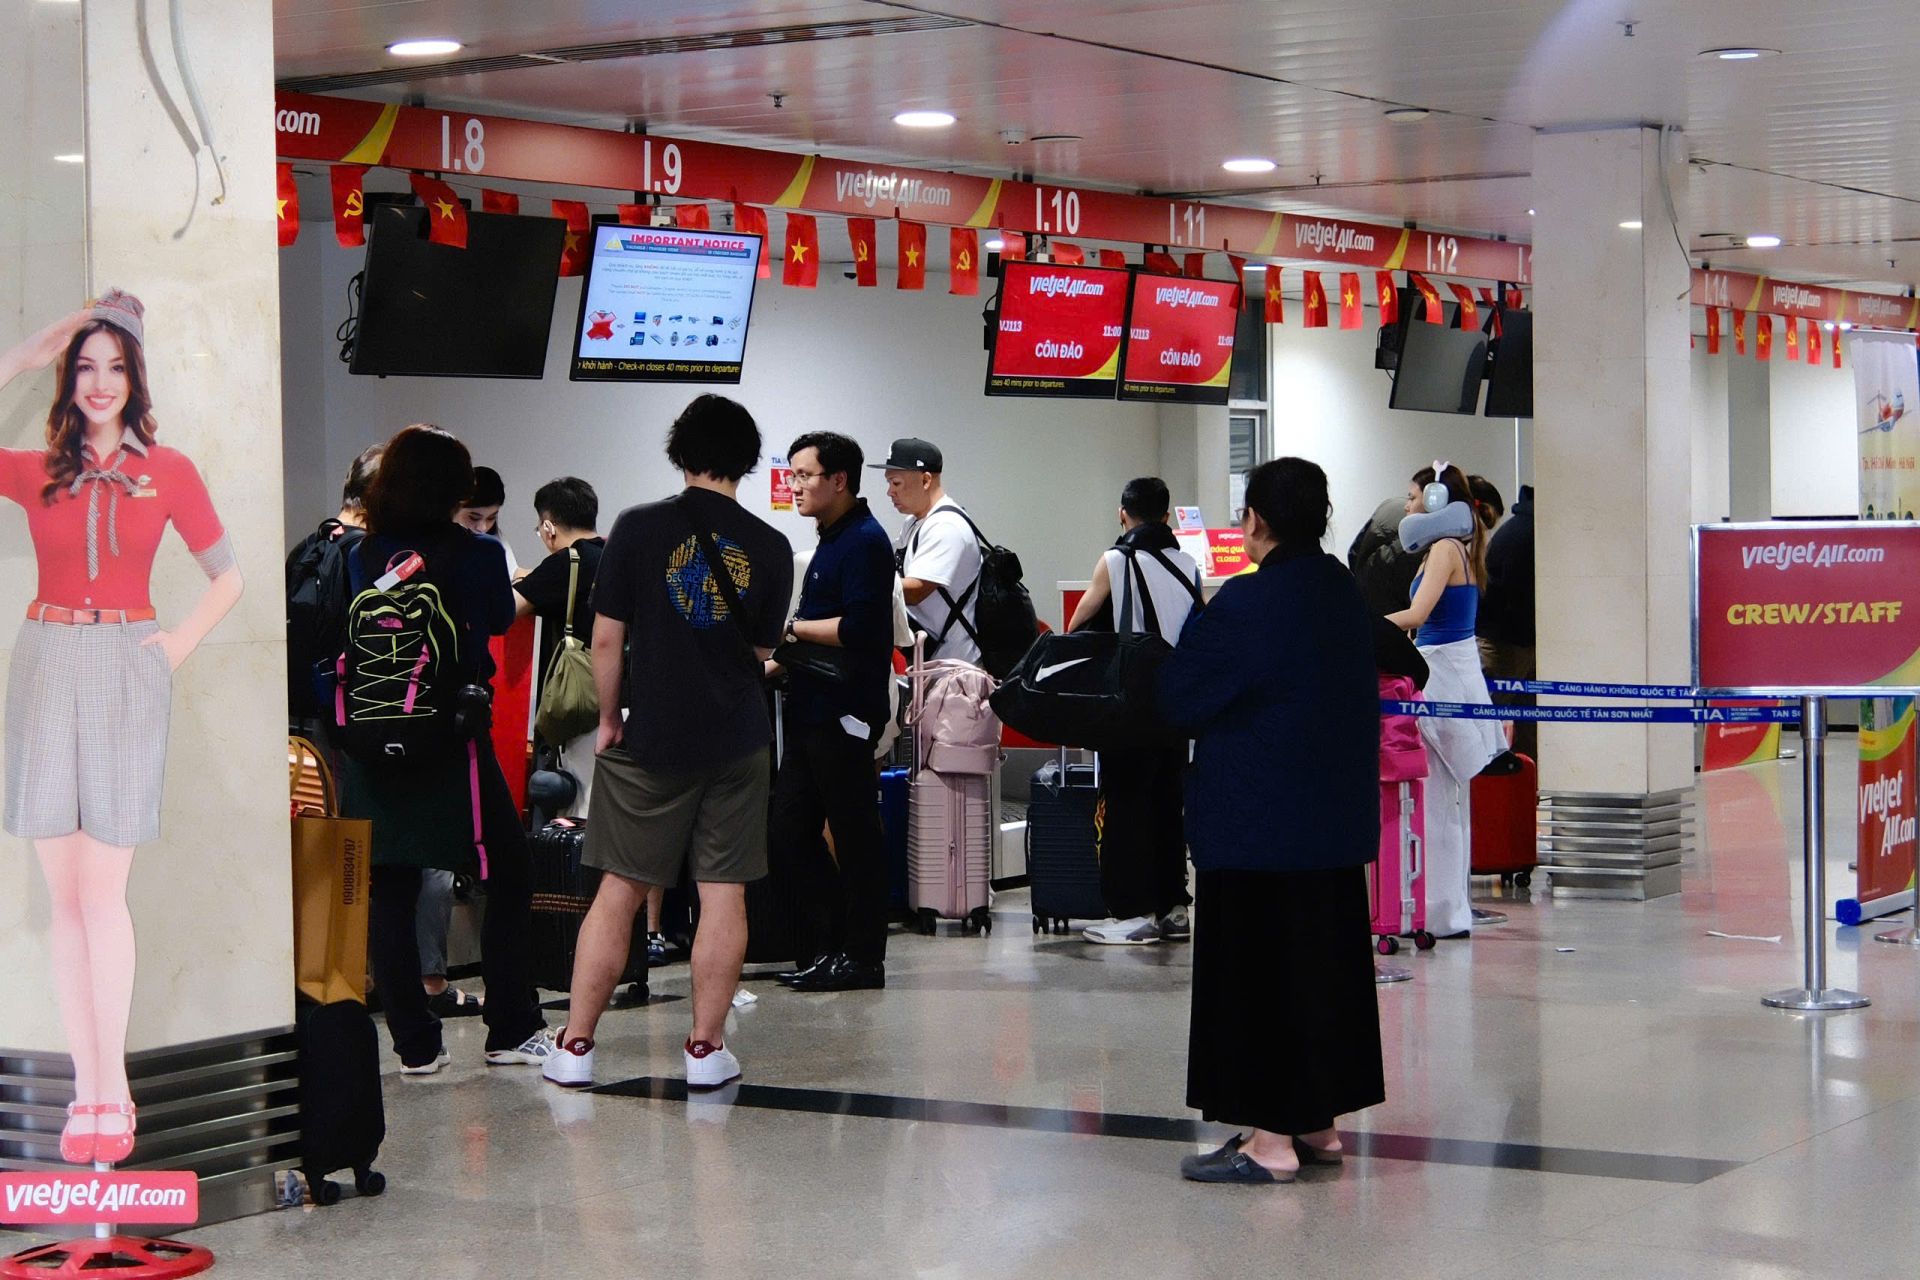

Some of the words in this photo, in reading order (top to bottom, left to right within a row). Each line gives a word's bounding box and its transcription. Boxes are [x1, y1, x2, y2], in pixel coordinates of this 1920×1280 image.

[442, 115, 485, 173] I.8
[643, 140, 682, 194] I.9
[1036, 188, 1080, 234] I.10
[1169, 203, 1206, 246] I.11
[631, 234, 700, 247] IMPORTANT
[703, 239, 745, 251] NOTICE
[1426, 234, 1458, 274] I.12
[1704, 272, 1728, 306] I.14
[1000, 320, 1022, 332] VJ113
[1102, 326, 1122, 336] 11:00
[1035, 340, 1058, 358] CÔN
[1060, 340, 1083, 359] ĐẢO
[1160, 348, 1179, 366] CÔN
[618, 362, 645, 370] Check-in
[646, 362, 665, 371] closes
[667, 363, 674, 371] 40
[690, 364, 704, 374] prior
[1726, 602, 1902, 624] CREW/STAFF
[1494, 680, 1524, 692] TIA
[1584, 684, 1607, 694] HÀNG
[1609, 686, 1638, 695] KHÔNG
[1399, 702, 1430, 714] TIA
[1498, 706, 1521, 717] HÀNG
[1523, 709, 1552, 718] KHÔNG
[1592, 709, 1609, 718] TÂN
[1611, 710, 1629, 718] SƠN
[1631, 708, 1654, 718] NHẤT
[1690, 709, 1724, 720] TIA
